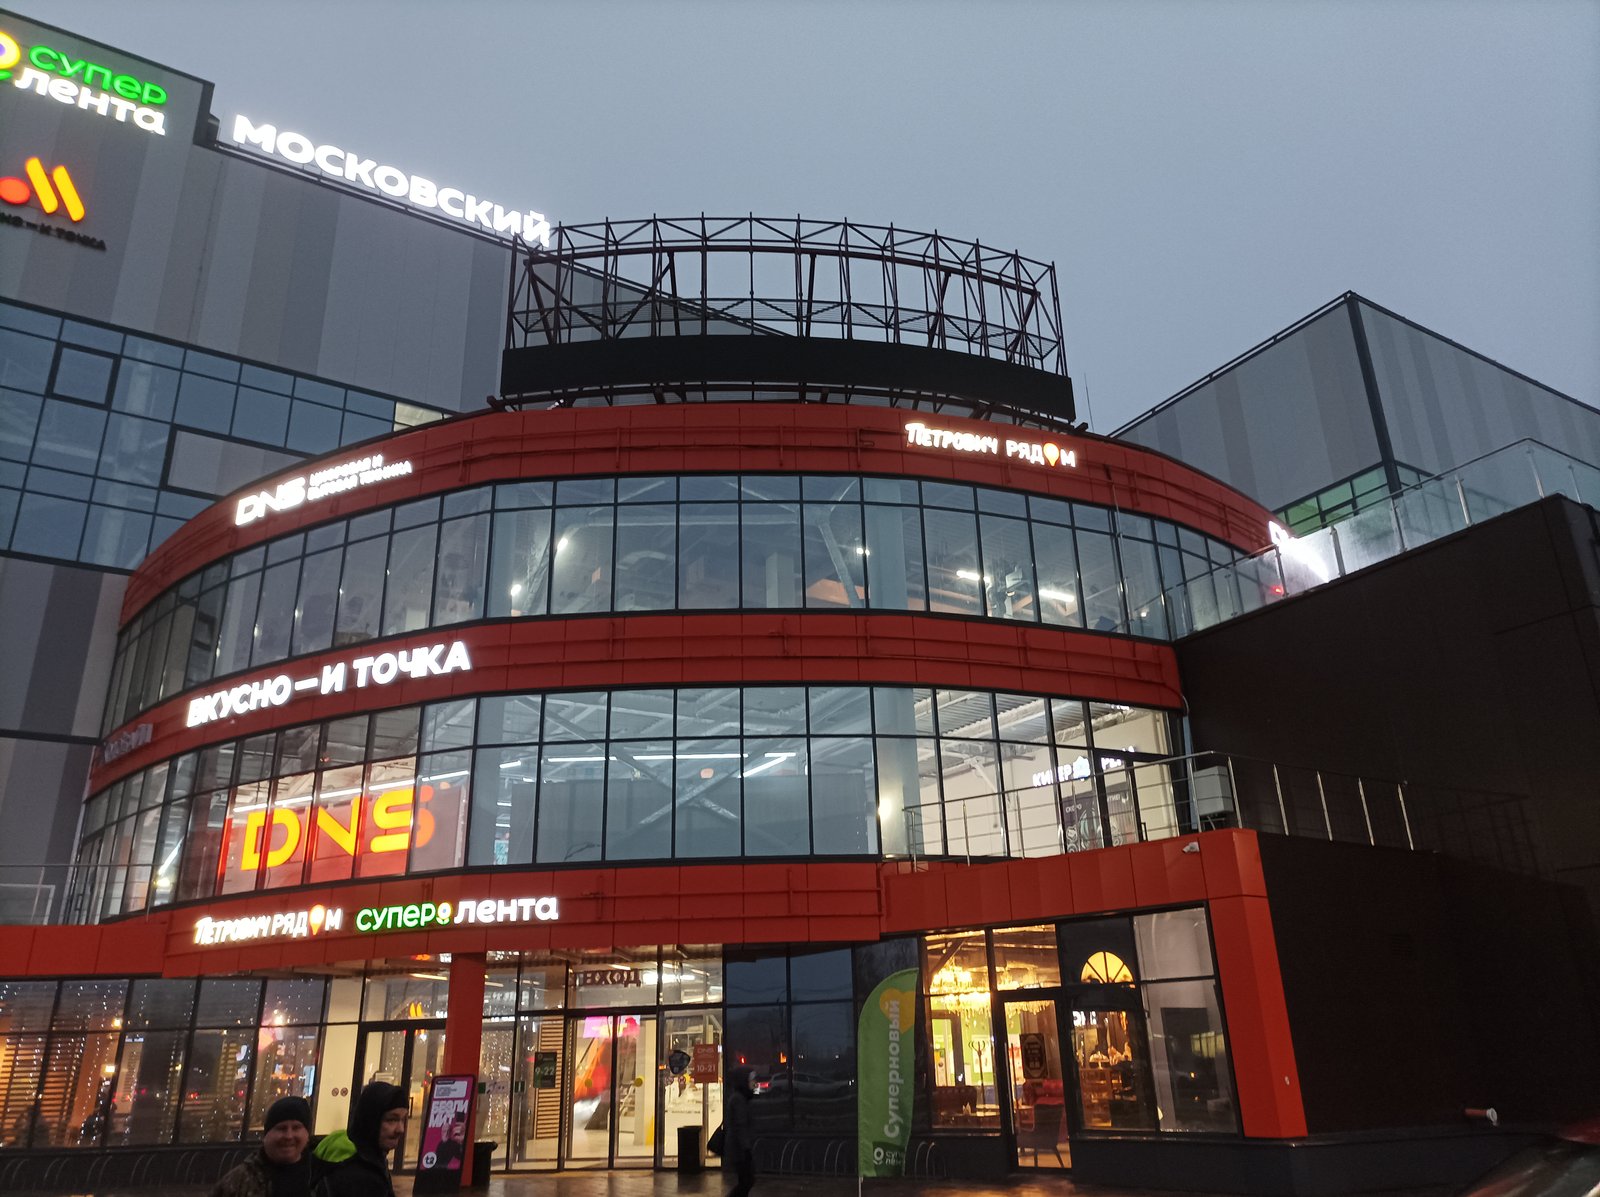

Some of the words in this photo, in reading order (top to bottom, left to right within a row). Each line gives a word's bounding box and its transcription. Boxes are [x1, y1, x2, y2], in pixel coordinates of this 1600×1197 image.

[14, 67, 166, 136] лента
[29, 45, 168, 105] супер
[232, 114, 551, 248] МОСКОВСКИЙ
[235, 476, 306, 526] DNS
[353, 640, 472, 689] ТОЧКА
[241, 785, 436, 871] DNS
[355, 902, 439, 932] супер
[453, 896, 559, 925] лента
[883, 998, 905, 1139] Суперновый
